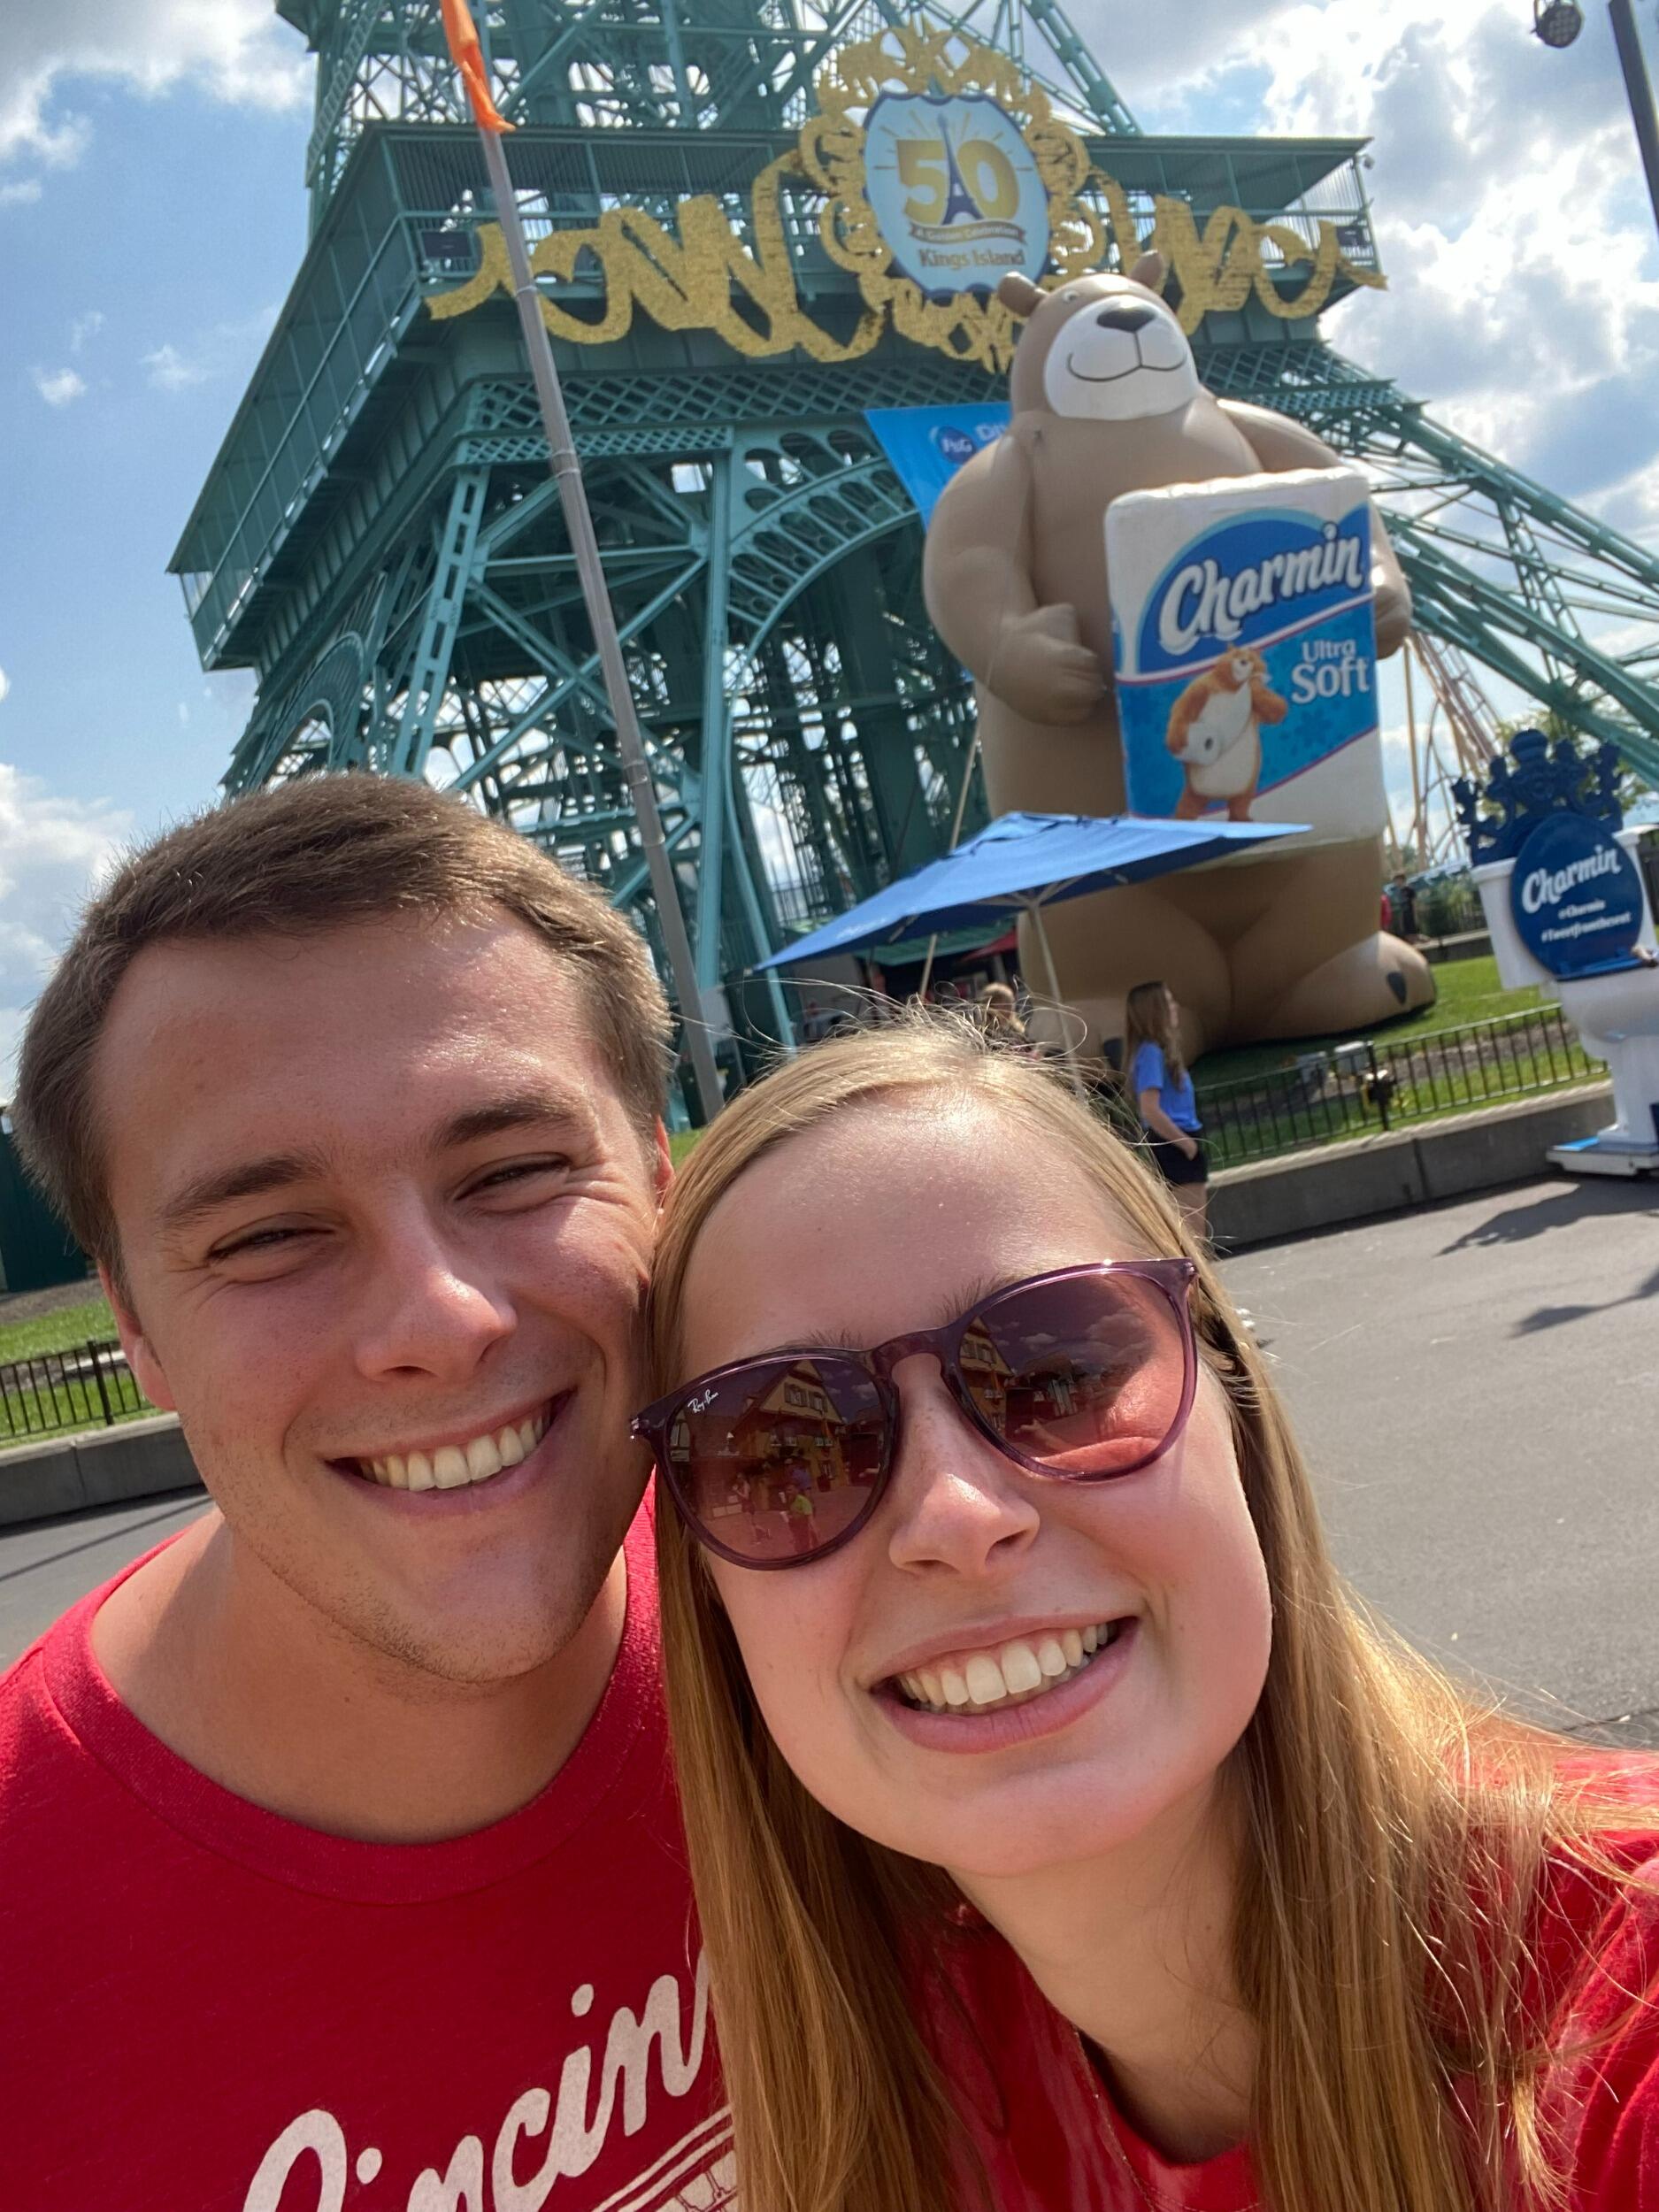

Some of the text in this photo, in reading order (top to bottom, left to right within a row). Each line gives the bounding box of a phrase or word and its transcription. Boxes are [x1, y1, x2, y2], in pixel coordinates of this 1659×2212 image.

[895, 139, 1019, 227] 50
[919, 249, 1025, 270] Kings Island
[1160, 524, 1363, 655] Charmin
[1302, 639, 1356, 664] Ultra
[1291, 656, 1370, 704] Soft
[1522, 844, 1623, 914] Charmin
[687, 1388, 719, 1414] Ray-Ban
